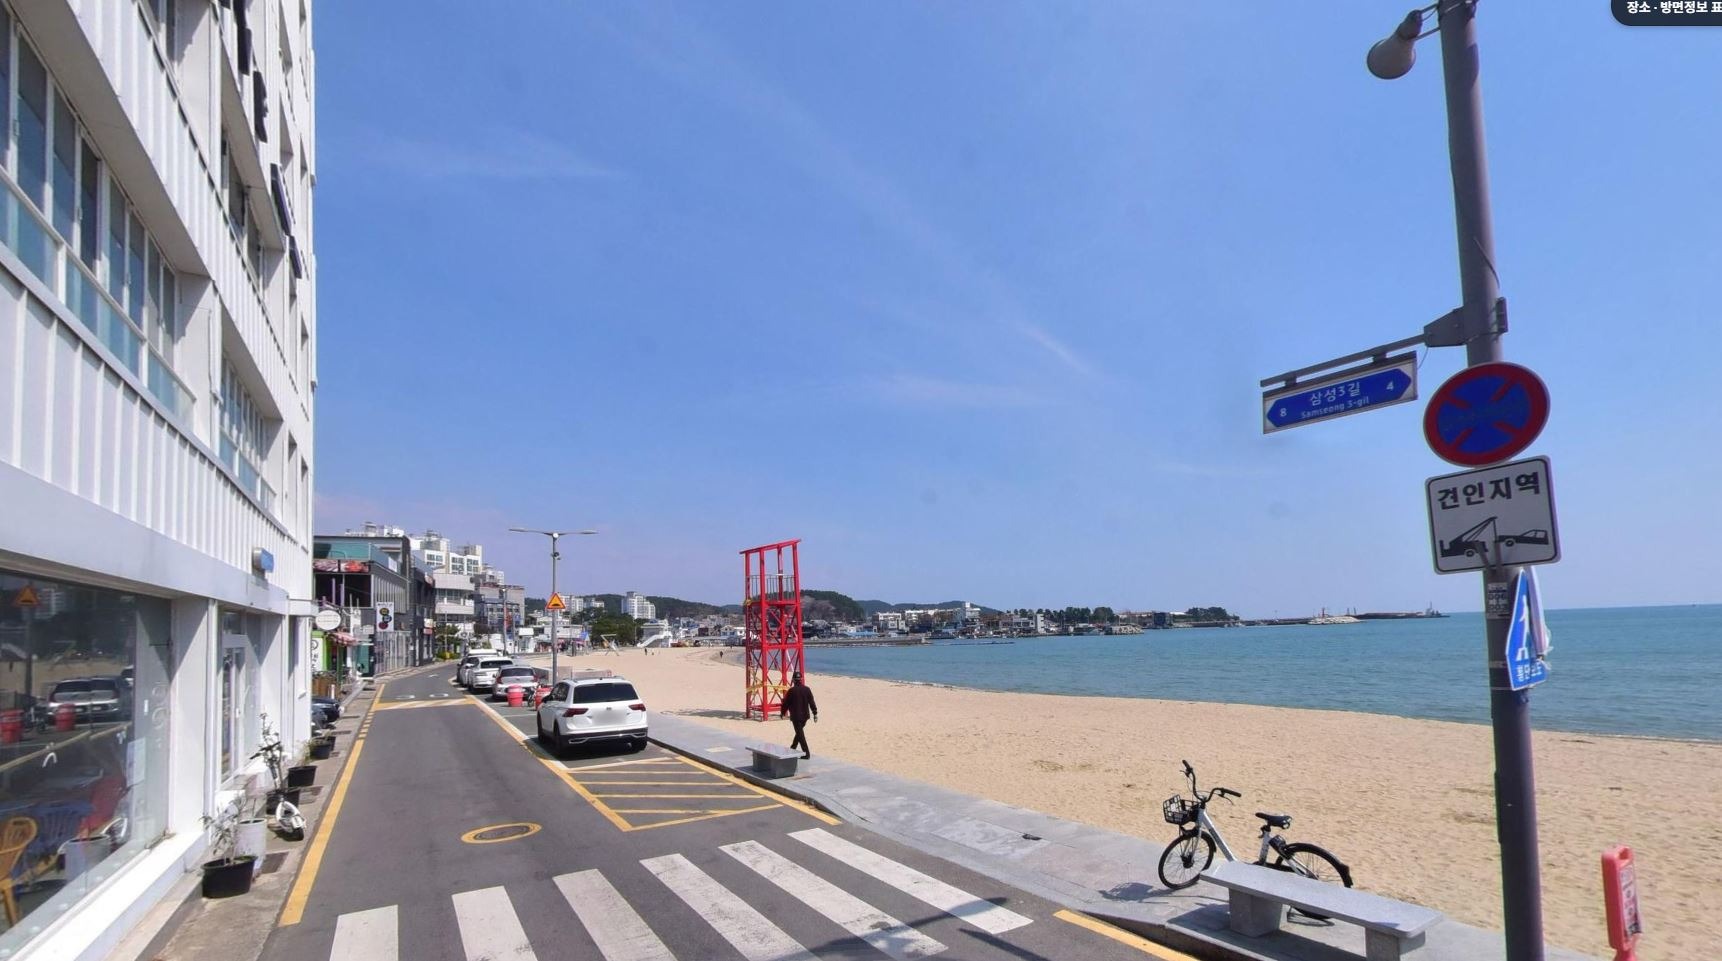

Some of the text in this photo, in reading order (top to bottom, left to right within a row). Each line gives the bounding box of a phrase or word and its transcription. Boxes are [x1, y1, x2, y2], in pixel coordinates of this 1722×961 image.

[1311, 382, 1360, 406] 삼성3길
[1386, 381, 1393, 391] 4
[1280, 408, 1287, 417] 8
[1301, 396, 1369, 418] Samseong 3-gil
[1438, 472, 1539, 510] 견인지역
